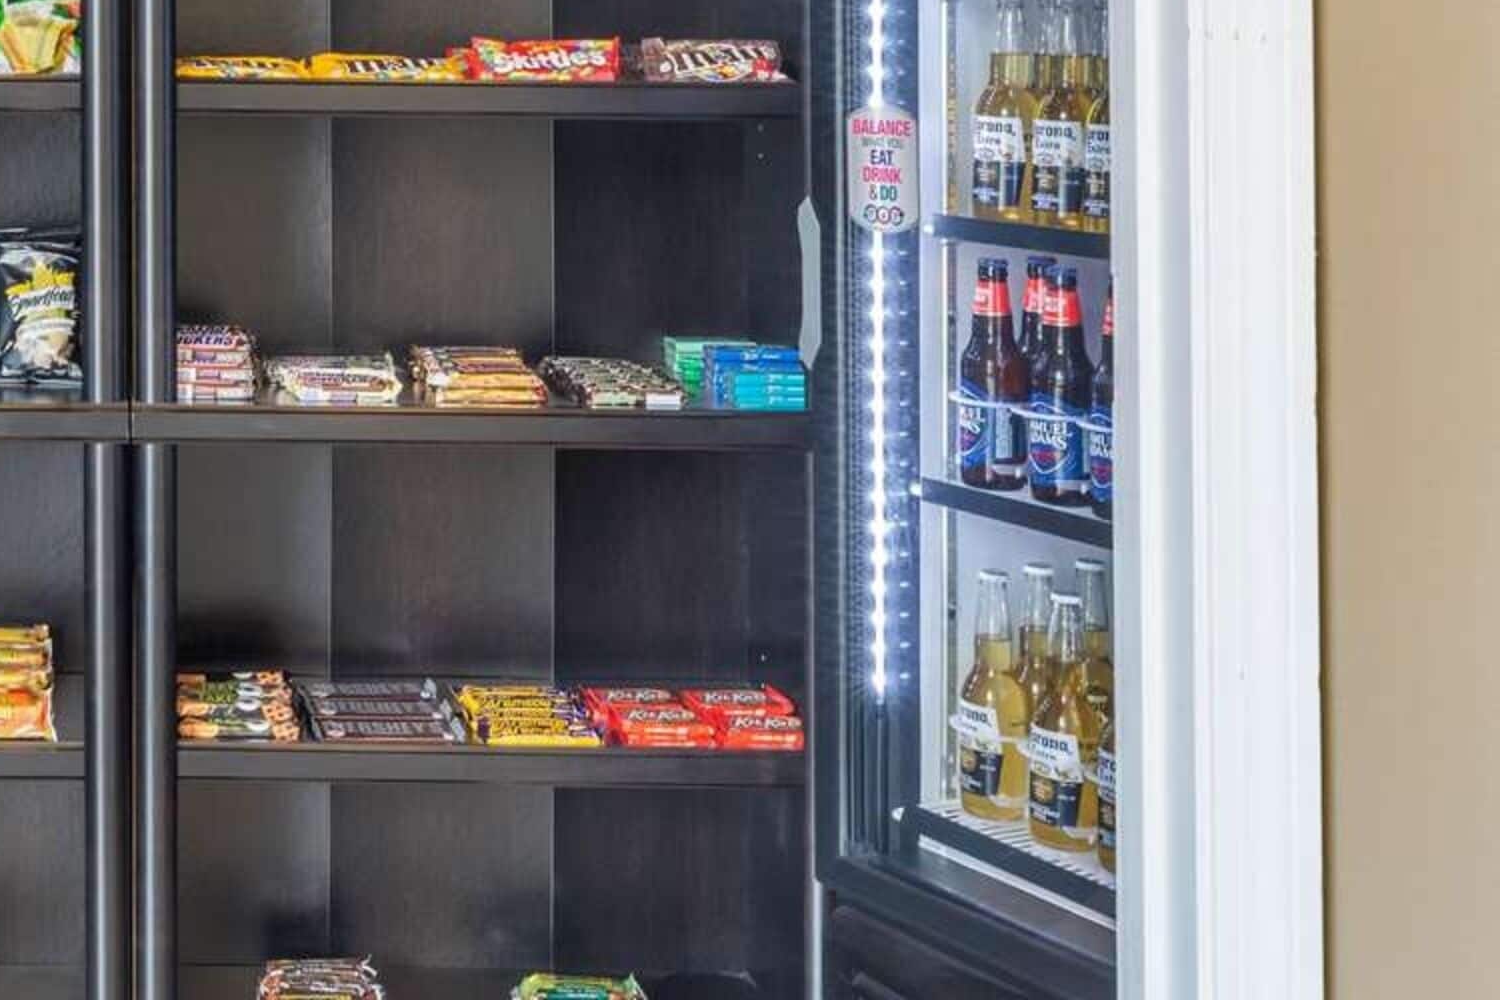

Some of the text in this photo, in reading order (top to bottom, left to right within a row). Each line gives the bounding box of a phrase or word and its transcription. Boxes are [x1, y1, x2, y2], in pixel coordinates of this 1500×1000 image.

[492, 47, 608, 74] Skittles
[852, 119, 910, 137] BALANCE
[870, 149, 894, 165] EAT
[862, 166, 902, 184] DRINK
[880, 185, 897, 201] DO
